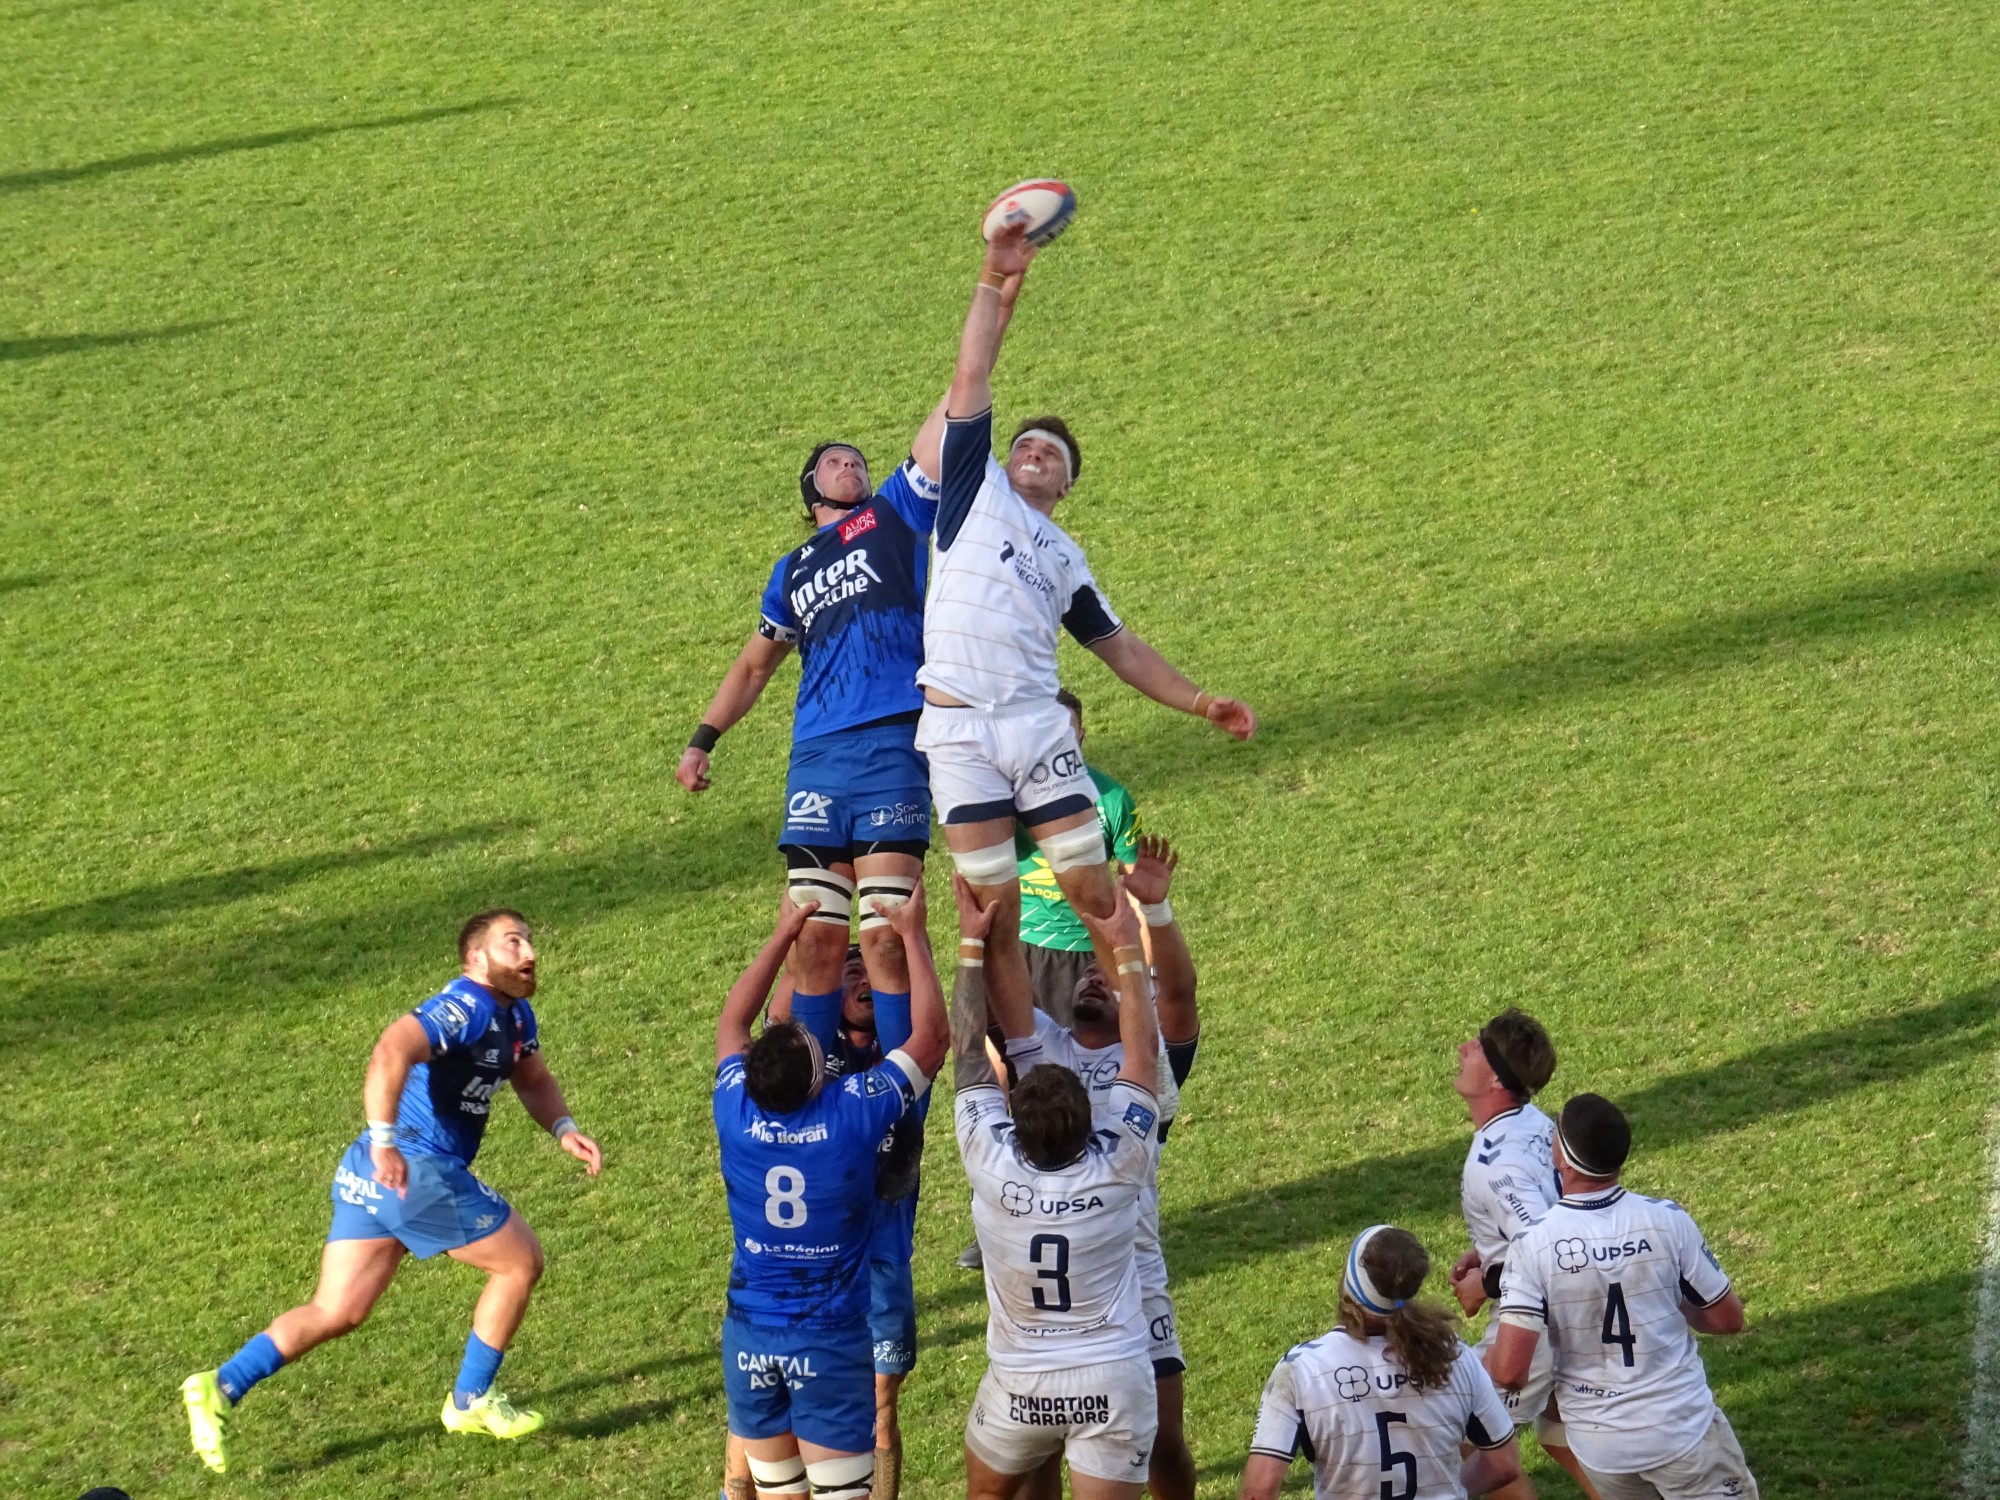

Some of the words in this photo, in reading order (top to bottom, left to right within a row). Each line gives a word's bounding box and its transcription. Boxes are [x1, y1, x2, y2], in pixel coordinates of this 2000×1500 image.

[1052, 749, 1083, 777] CFA
[806, 825, 831, 833] FRANCE
[765, 1165, 808, 1229] 8
[1040, 1195, 1104, 1215] UPSA
[1593, 1239, 1653, 1261] UPSA
[1029, 1233, 1072, 1313] 3
[1601, 1282, 1636, 1367] 4
[737, 1350, 817, 1379] CANTAL
[1008, 1392, 1109, 1412] FONDATION
[1009, 1406, 1109, 1426] CLARA.ORG
[1375, 1411, 1418, 1500] 5
